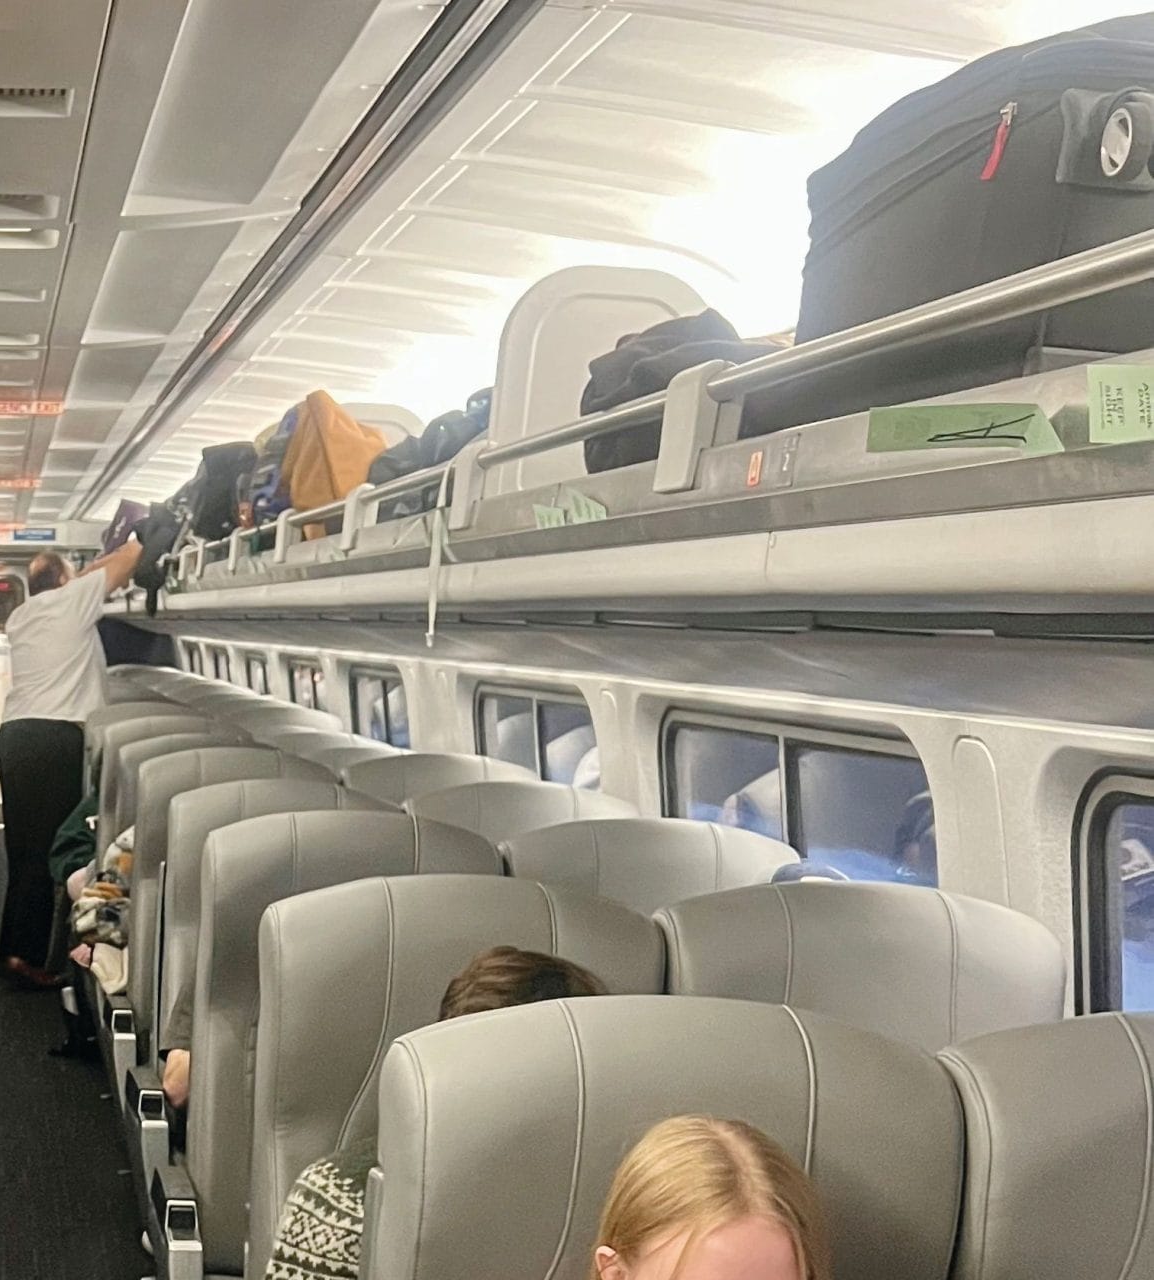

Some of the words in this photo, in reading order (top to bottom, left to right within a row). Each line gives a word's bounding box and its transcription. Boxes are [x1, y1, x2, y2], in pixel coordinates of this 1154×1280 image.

[1105, 385, 1113, 424] SIGHT
[1116, 387, 1124, 426] KEEP
[1137, 388, 1145, 423] DATE
